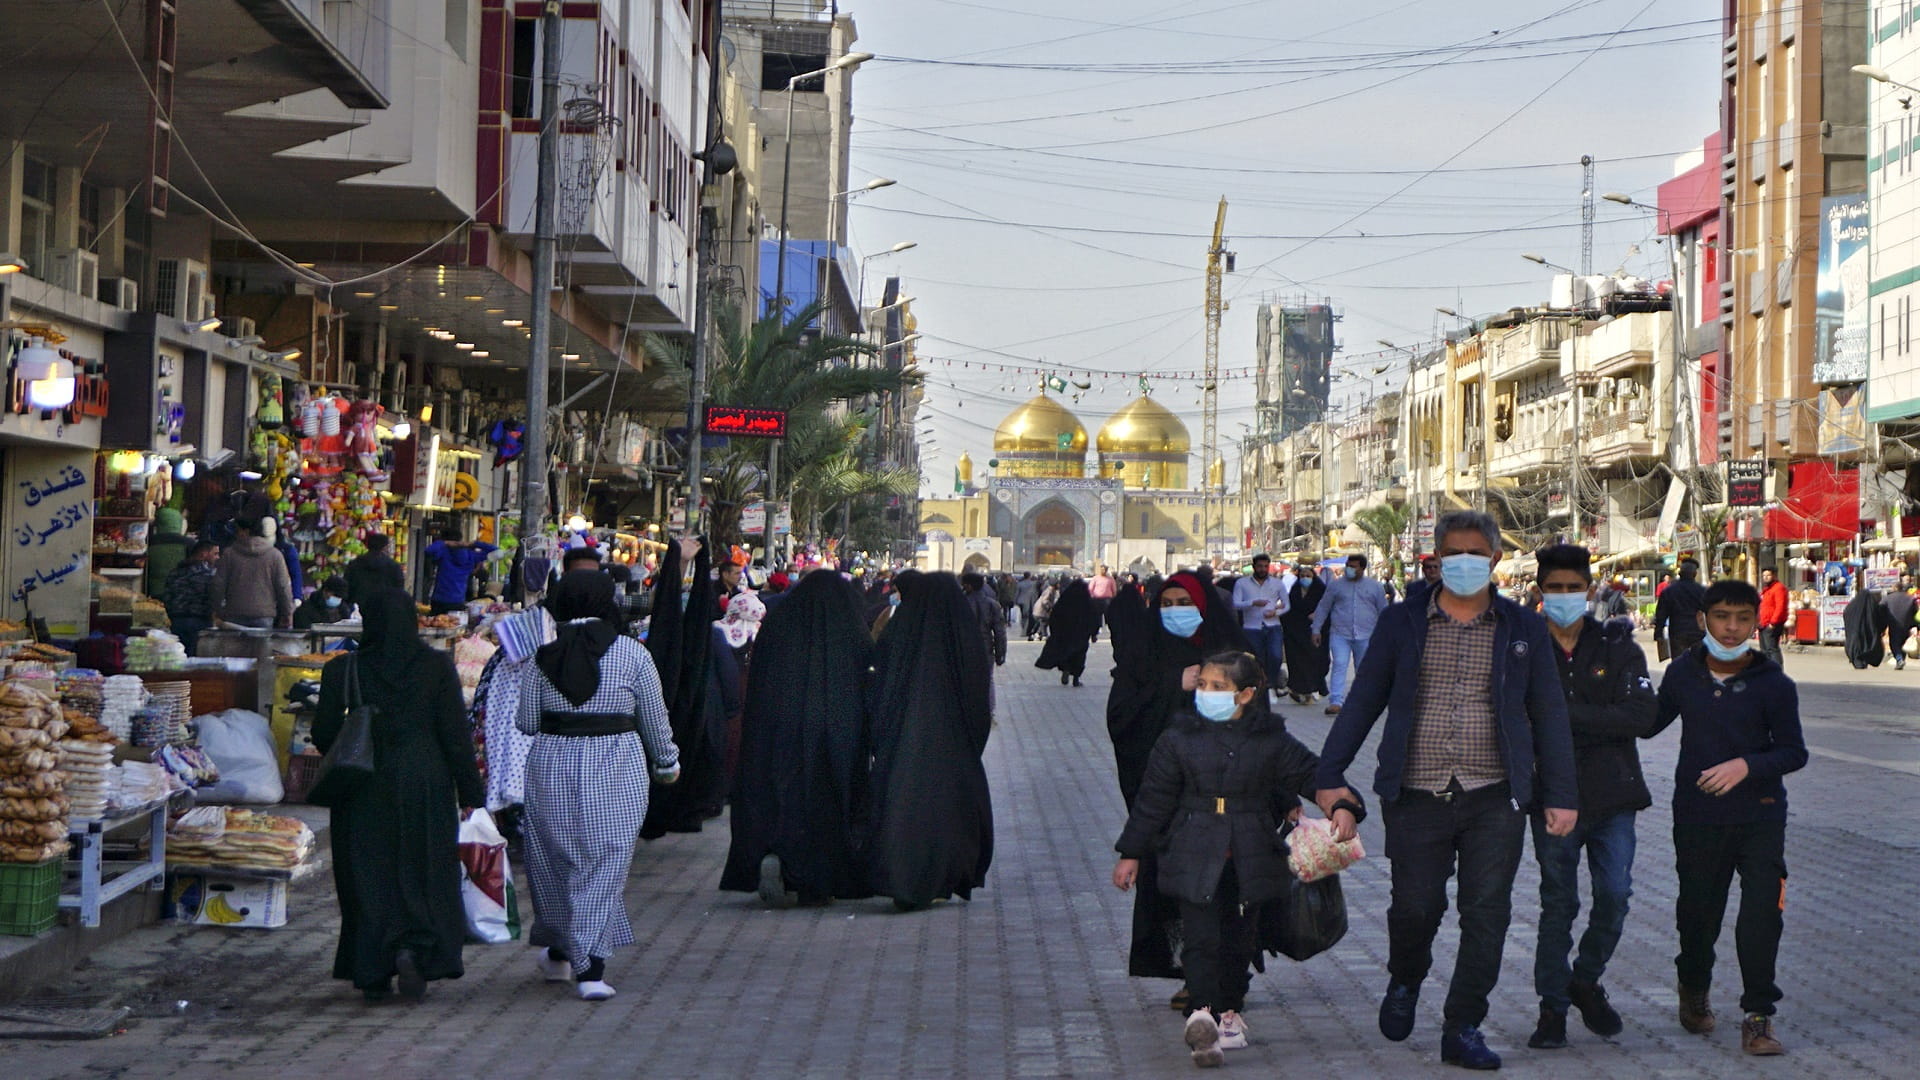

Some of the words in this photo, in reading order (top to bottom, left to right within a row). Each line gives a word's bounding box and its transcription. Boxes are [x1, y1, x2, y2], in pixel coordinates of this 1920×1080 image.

[1731, 462, 1762, 470] Hotel
[1731, 470, 1762, 481] فندق
[19, 465, 87, 507] فندق
